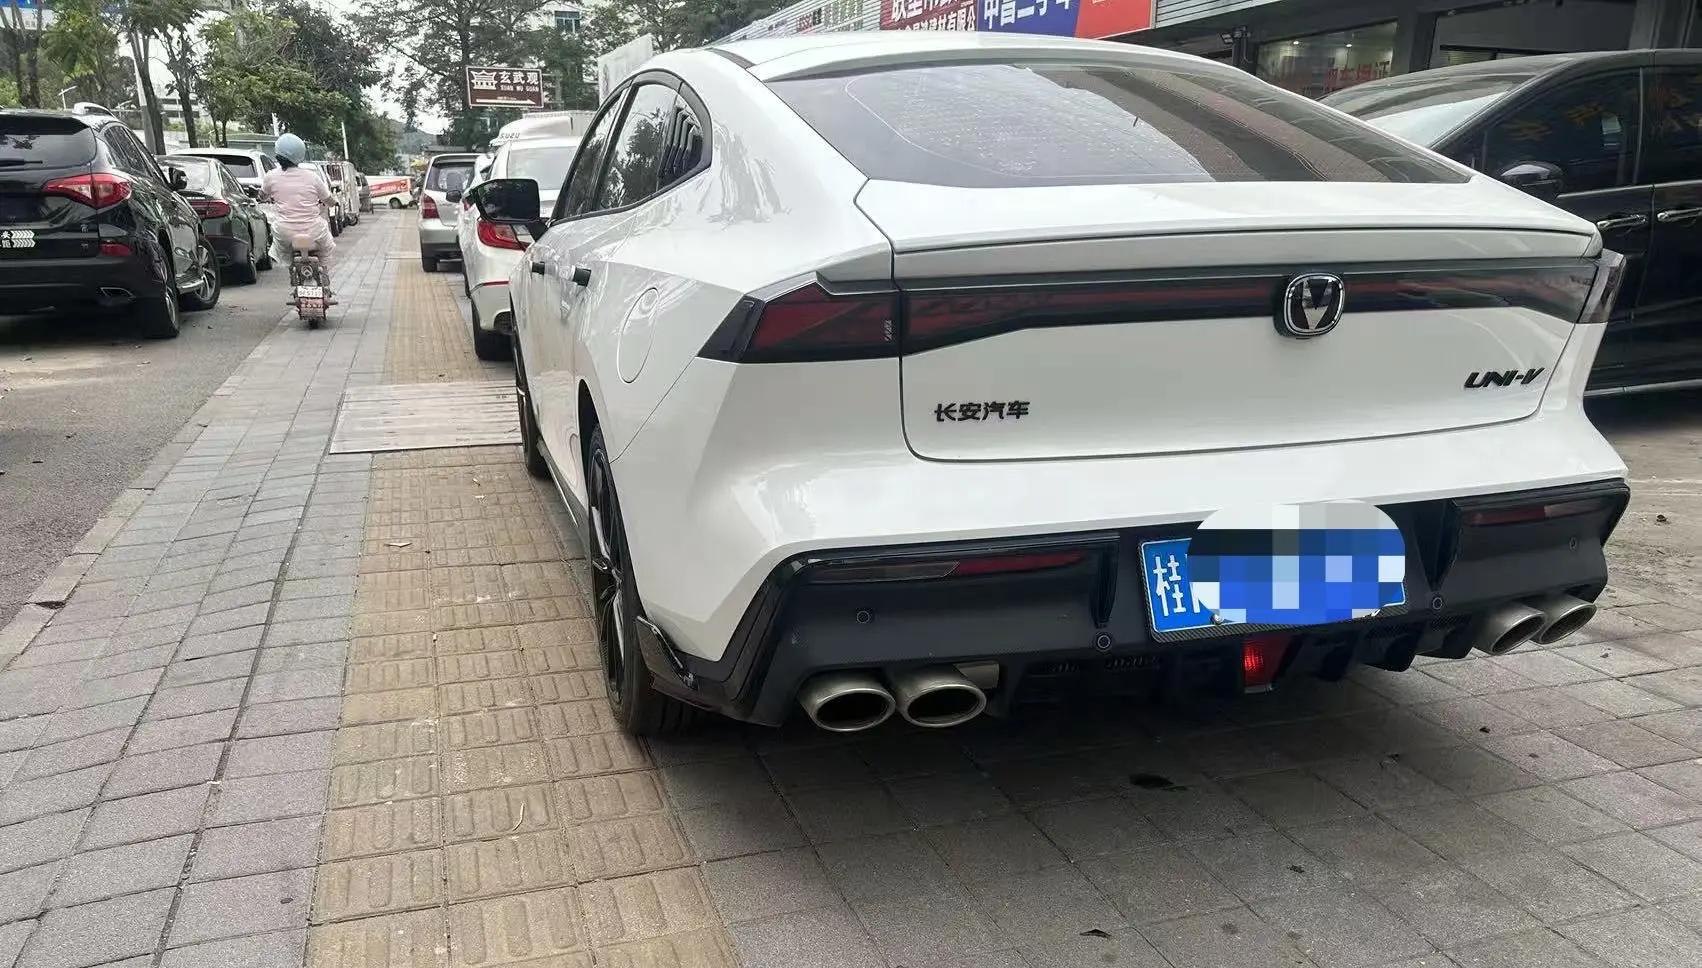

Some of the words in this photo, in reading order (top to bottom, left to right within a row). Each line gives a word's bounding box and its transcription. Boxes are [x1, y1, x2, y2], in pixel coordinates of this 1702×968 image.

[499, 71, 539, 85] 玄武观
[1464, 367, 1546, 388] UNI-V
[934, 400, 1031, 422] 长安汽车
